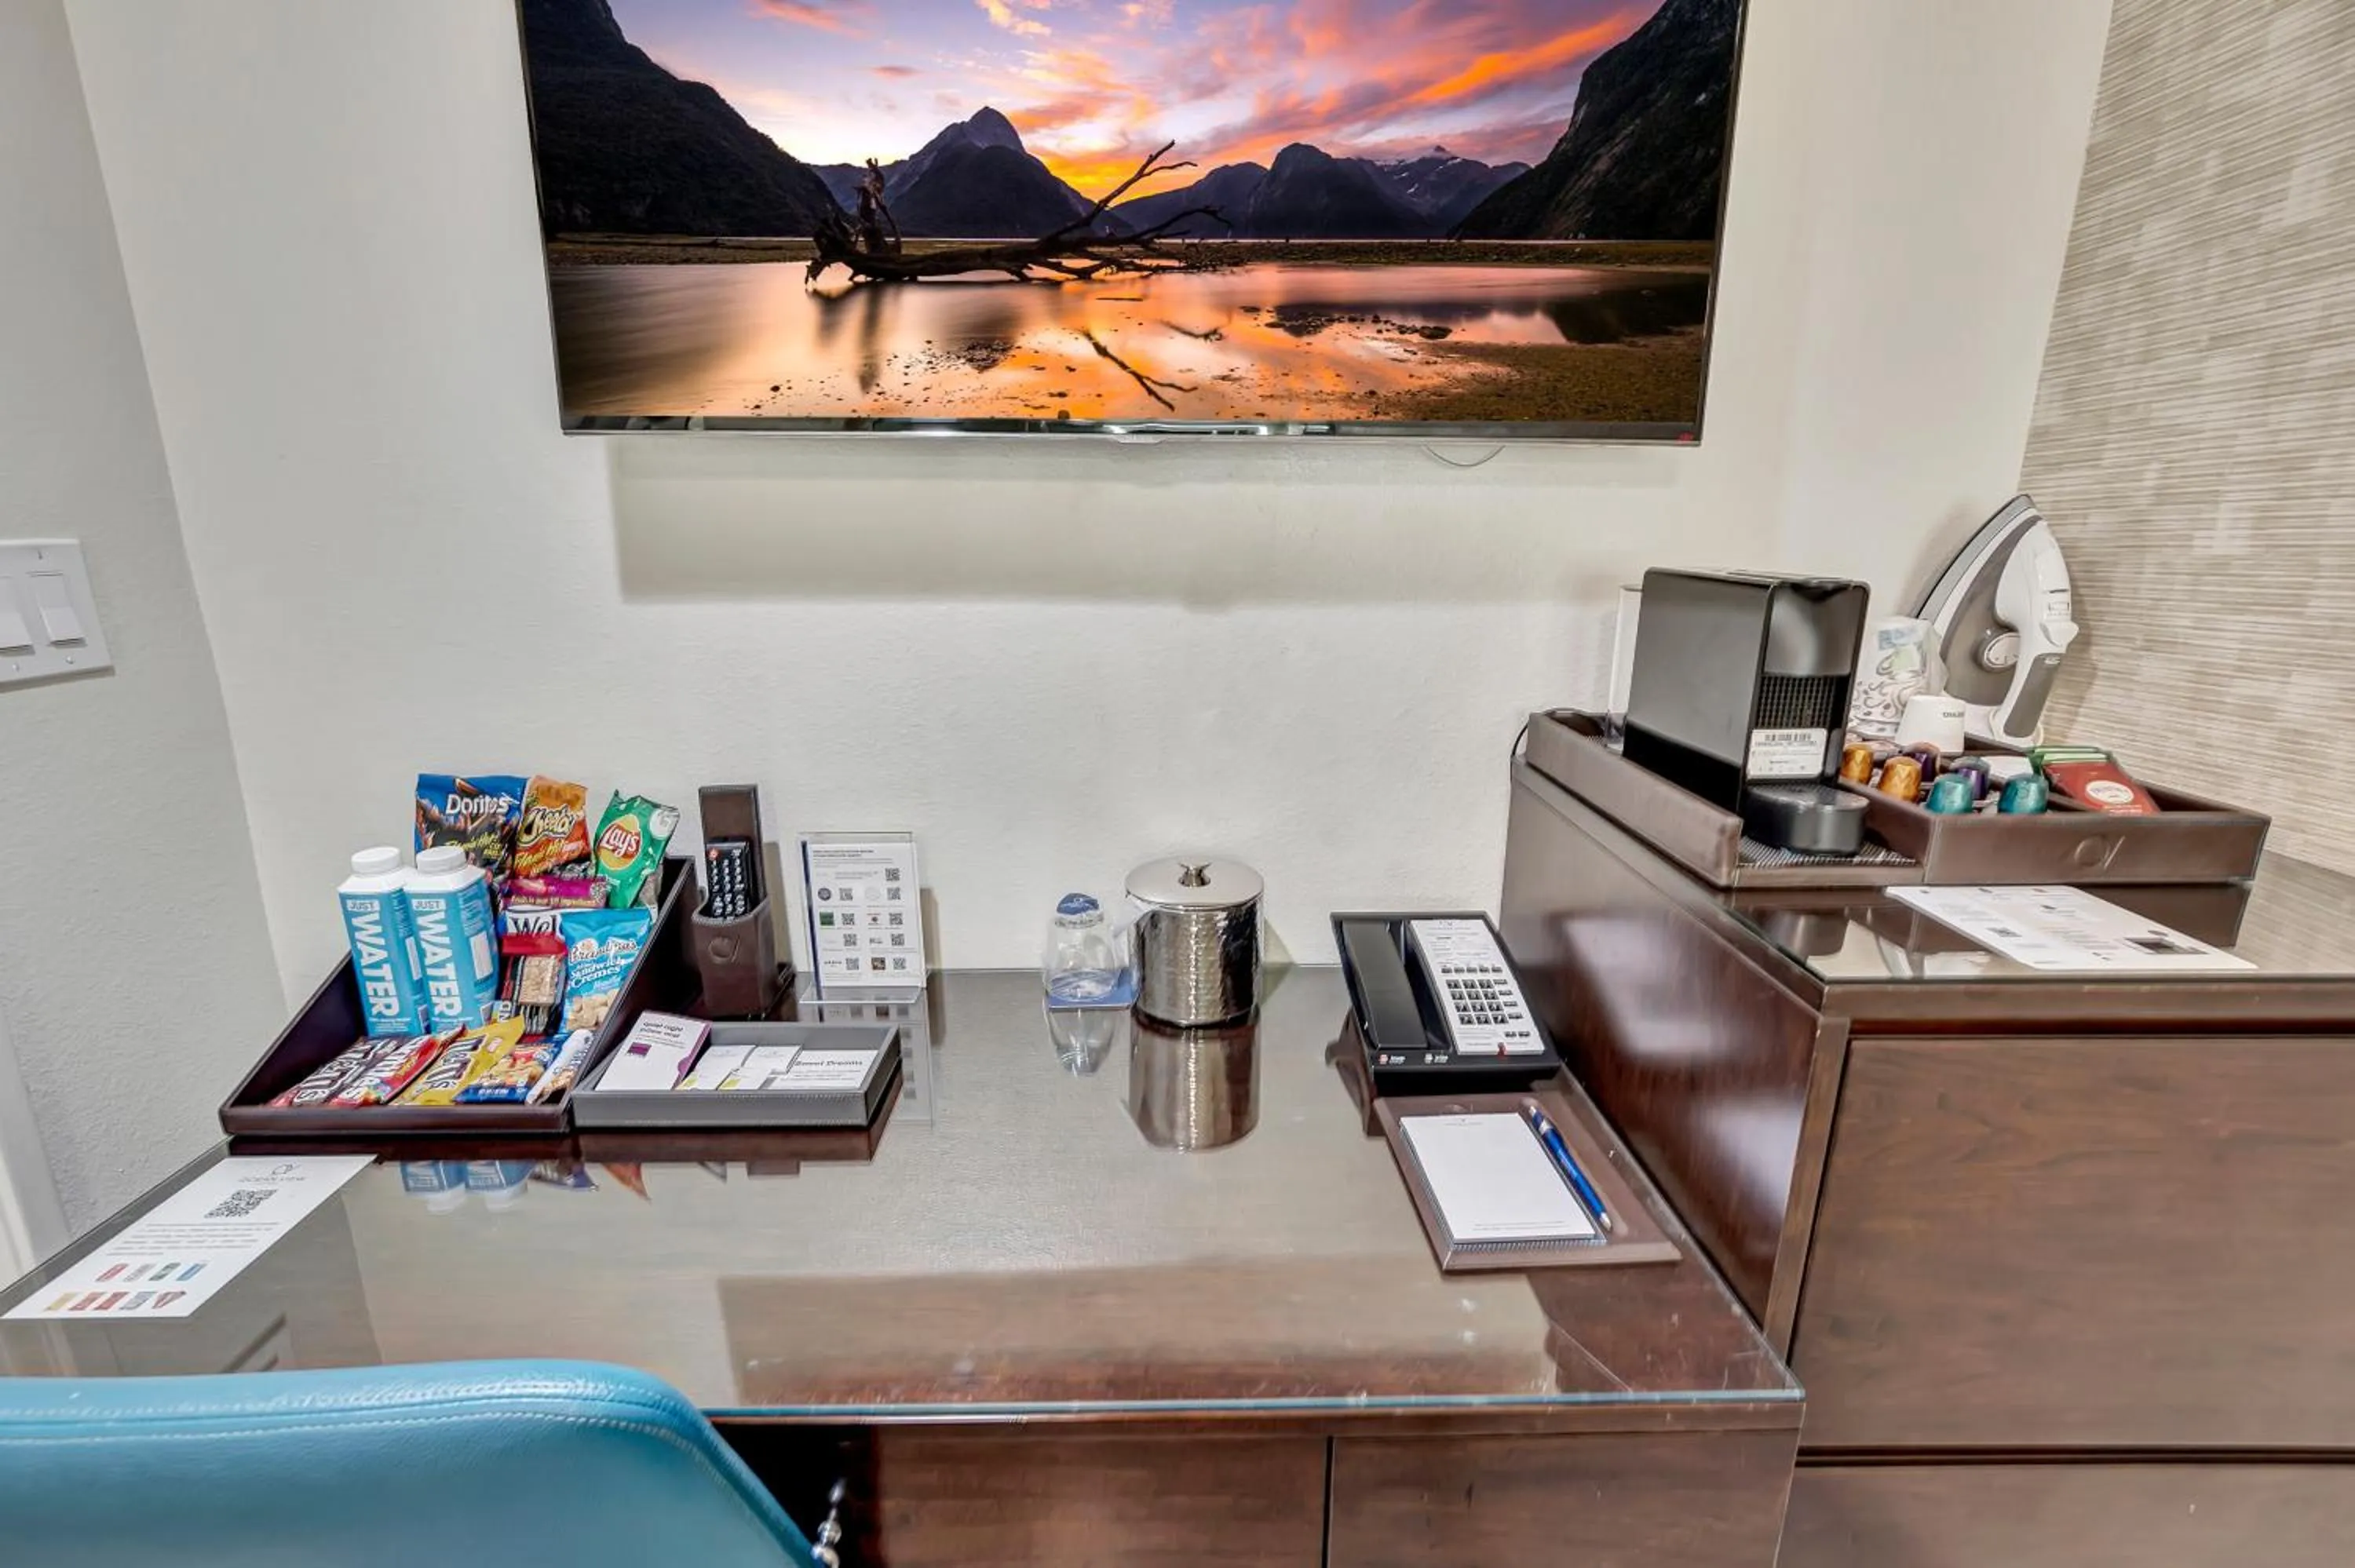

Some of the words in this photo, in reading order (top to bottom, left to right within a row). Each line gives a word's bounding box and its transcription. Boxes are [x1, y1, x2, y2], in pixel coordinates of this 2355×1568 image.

[445, 793, 510, 815] Doritos
[599, 824, 640, 858] Lay's
[349, 902, 377, 910] JUST
[415, 902, 442, 910] JUST
[351, 911, 400, 1016] WATER
[417, 911, 462, 1016] WATER
